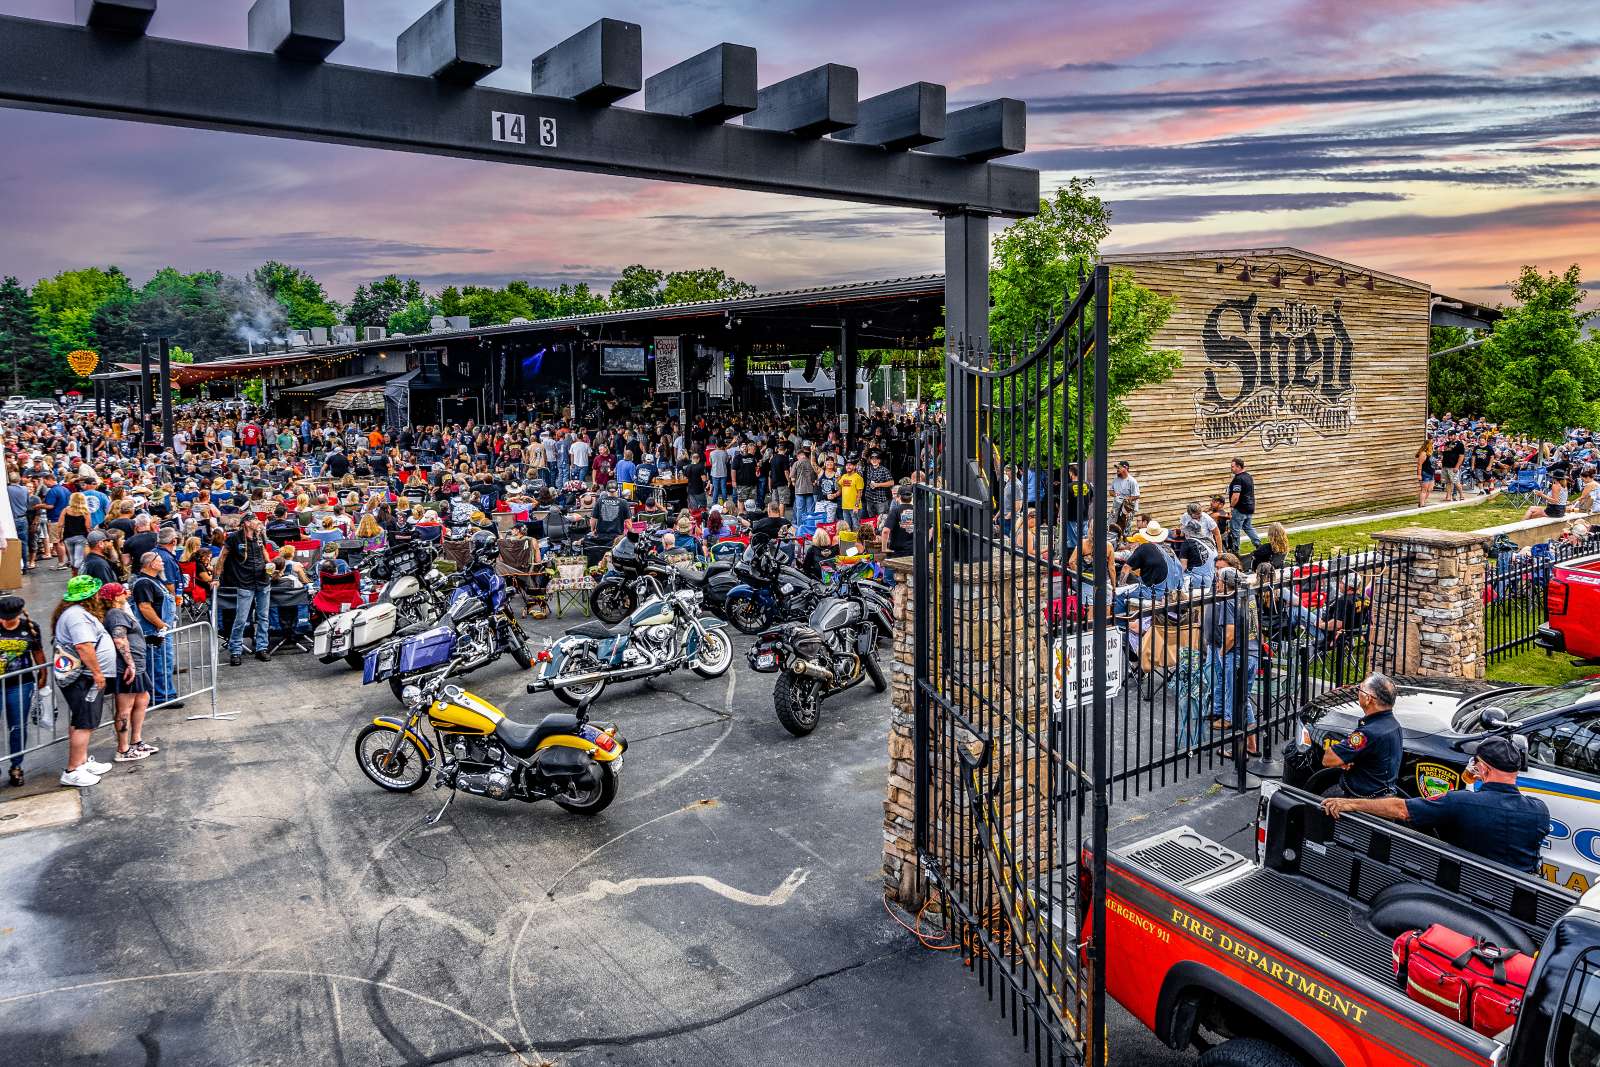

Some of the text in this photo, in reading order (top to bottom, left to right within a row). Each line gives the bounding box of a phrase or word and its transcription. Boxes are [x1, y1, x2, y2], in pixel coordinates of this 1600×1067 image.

[496, 113, 555, 146] 14 3
[1105, 898, 1171, 944] MERGENCY 911
[1170, 908, 1368, 1024] FIRE DEPARTMENT
